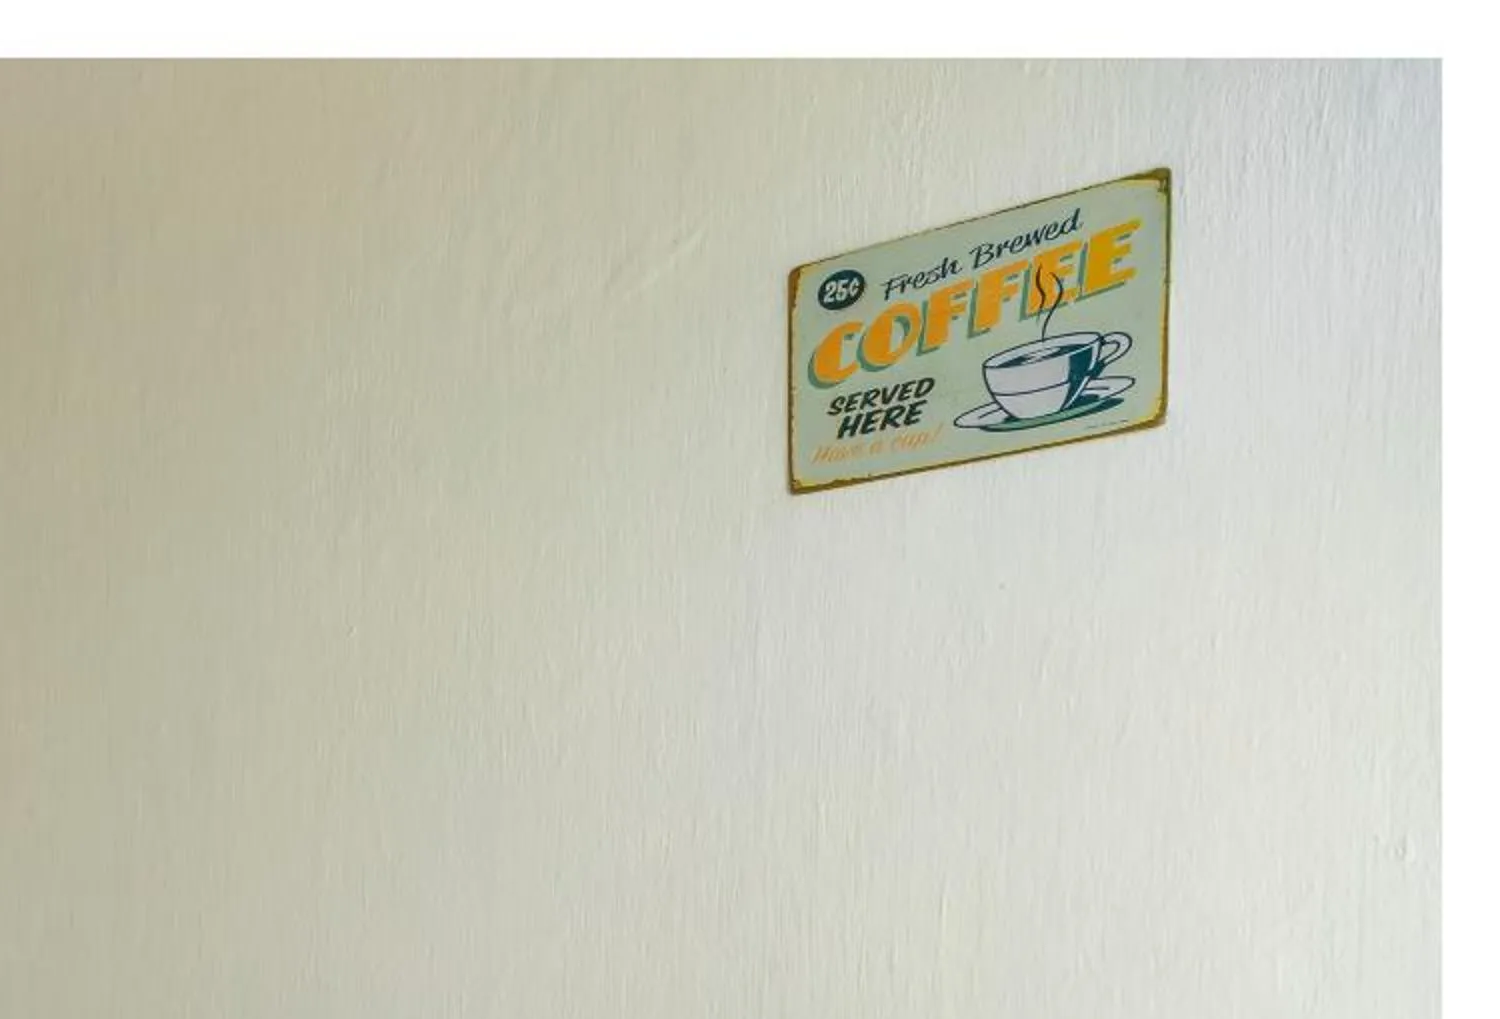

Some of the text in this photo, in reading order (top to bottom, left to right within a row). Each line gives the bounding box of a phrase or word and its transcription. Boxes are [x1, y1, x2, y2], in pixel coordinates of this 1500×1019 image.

[883, 207, 1082, 301] Fresh Brewed
[808, 219, 1143, 389] COFFEE
[826, 377, 936, 417] SERVED
[836, 400, 928, 440] HERE
